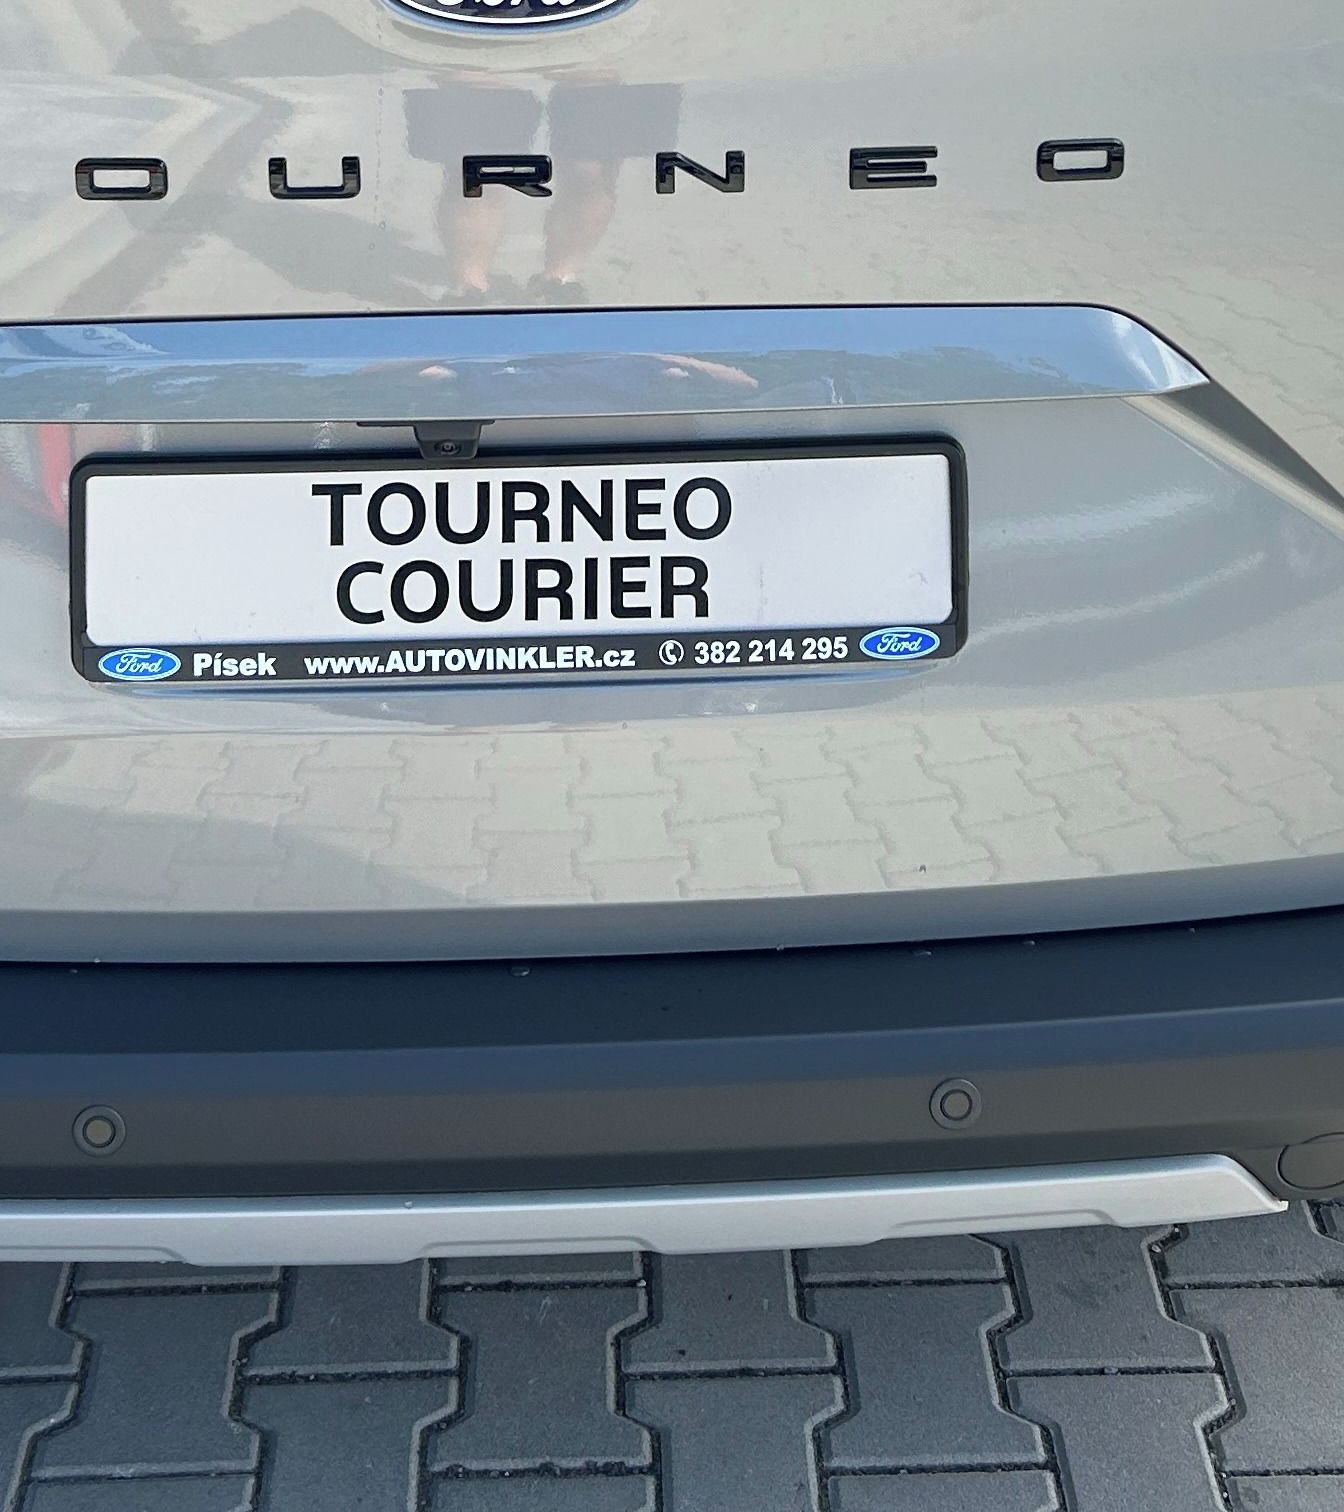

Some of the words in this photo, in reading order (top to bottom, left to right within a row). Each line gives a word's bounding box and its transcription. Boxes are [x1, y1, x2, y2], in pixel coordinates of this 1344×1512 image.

[311, 477, 733, 547] TOURNEO
[336, 555, 710, 626] COURIER
[193, 651, 277, 677] Písek
[304, 645, 636, 676] www.AUTOVINKLER.cz
[694, 643, 741, 665] 382
[749, 640, 796, 663] 214
[801, 637, 850, 661] 295
[875, 632, 923, 654] Ford
[114, 652, 165, 675] Ford
